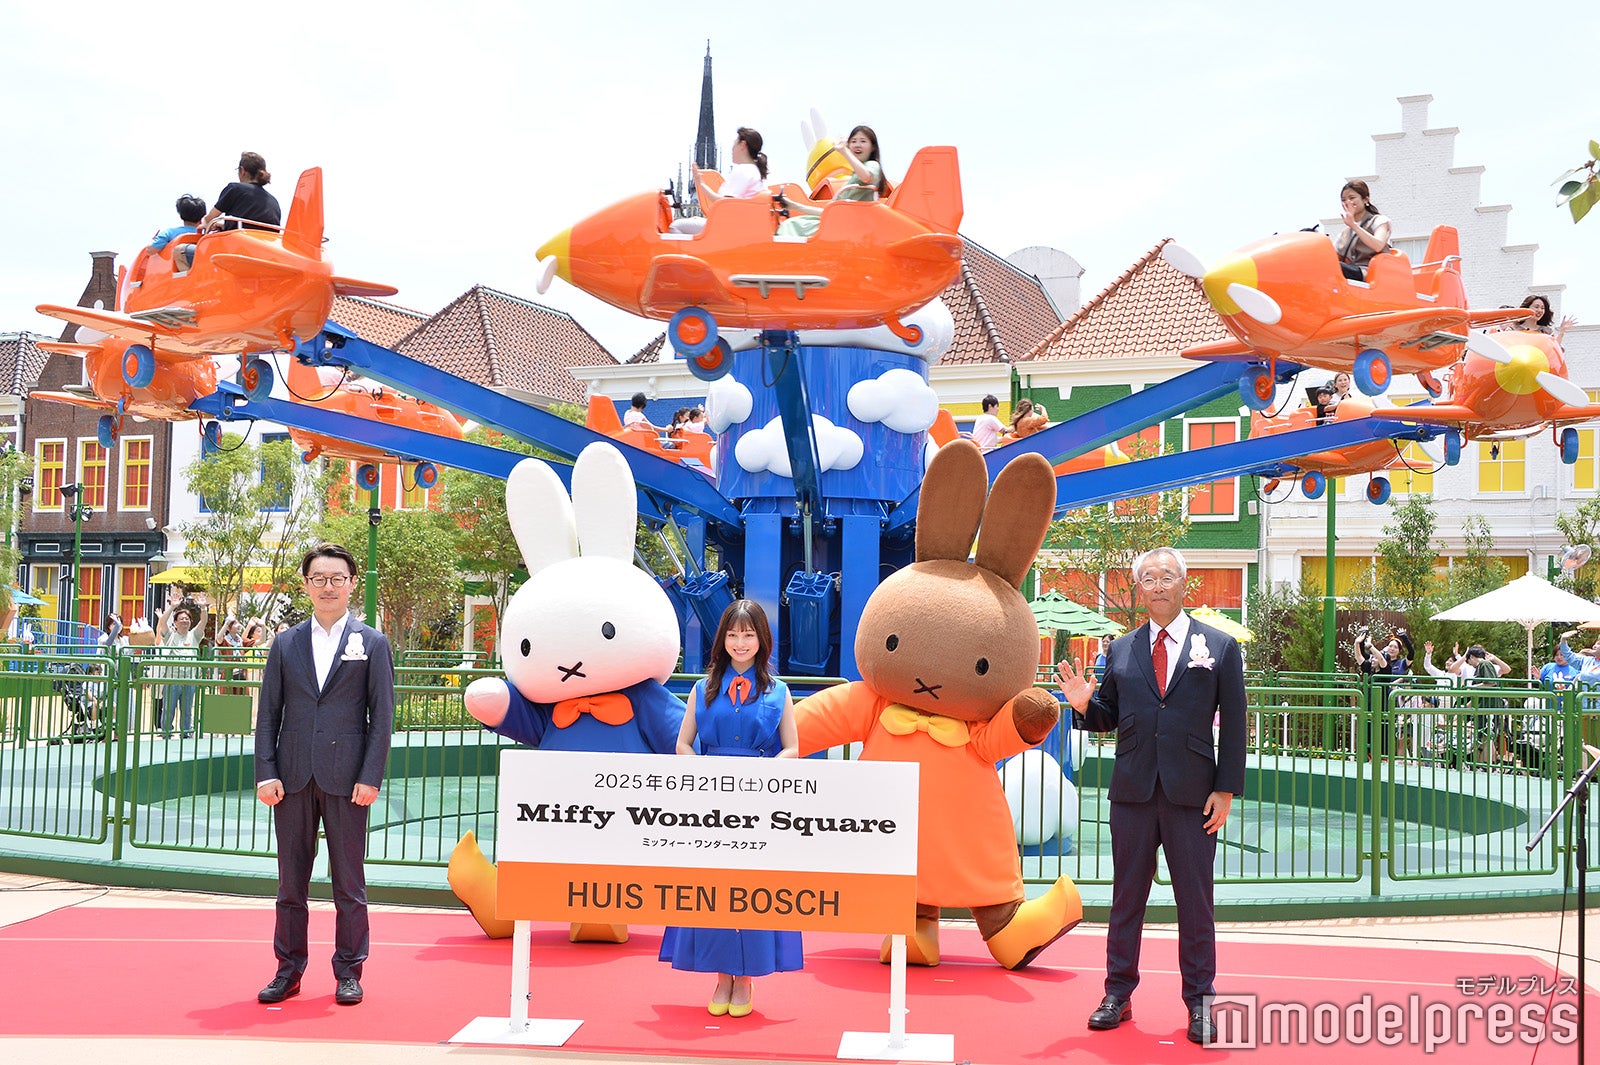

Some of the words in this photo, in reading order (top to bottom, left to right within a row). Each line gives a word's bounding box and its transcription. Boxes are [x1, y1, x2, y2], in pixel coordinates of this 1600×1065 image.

[517, 803, 615, 830] Miffy
[626, 806, 759, 830] Wonder
[771, 810, 897, 837] Square
[642, 837, 768, 850] ミッフィー・ワンダースクエア
[567, 881, 643, 910] HUIS
[654, 884, 717, 912] TEN
[730, 886, 840, 916] BOSCH
